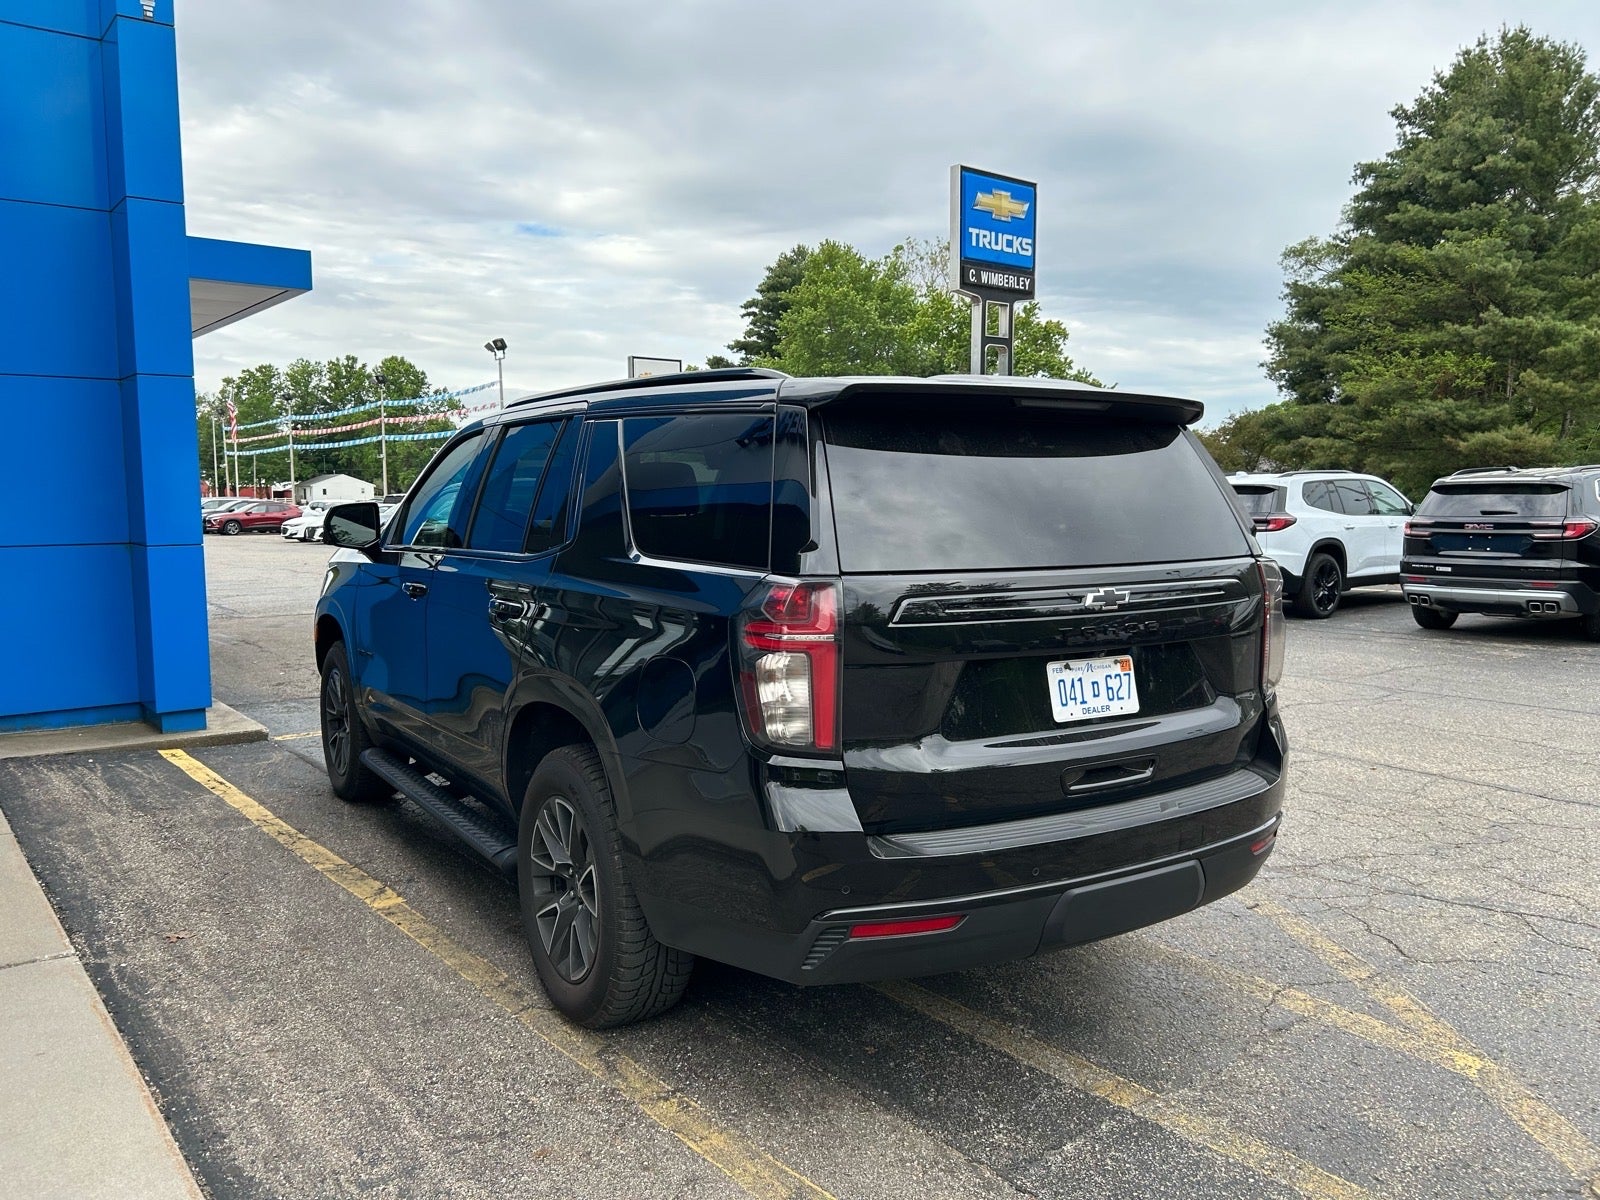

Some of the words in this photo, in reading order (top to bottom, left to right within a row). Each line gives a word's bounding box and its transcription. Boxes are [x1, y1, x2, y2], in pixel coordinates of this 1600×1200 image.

[968, 227, 1032, 256] TRUCKS
[969, 269, 977, 282] C.
[980, 270, 1031, 290] WIMBERLEY
[1057, 676, 1087, 707] 041
[1091, 681, 1100, 698] D
[1105, 672, 1131, 701] 627
[1082, 704, 1111, 715] DEALER
